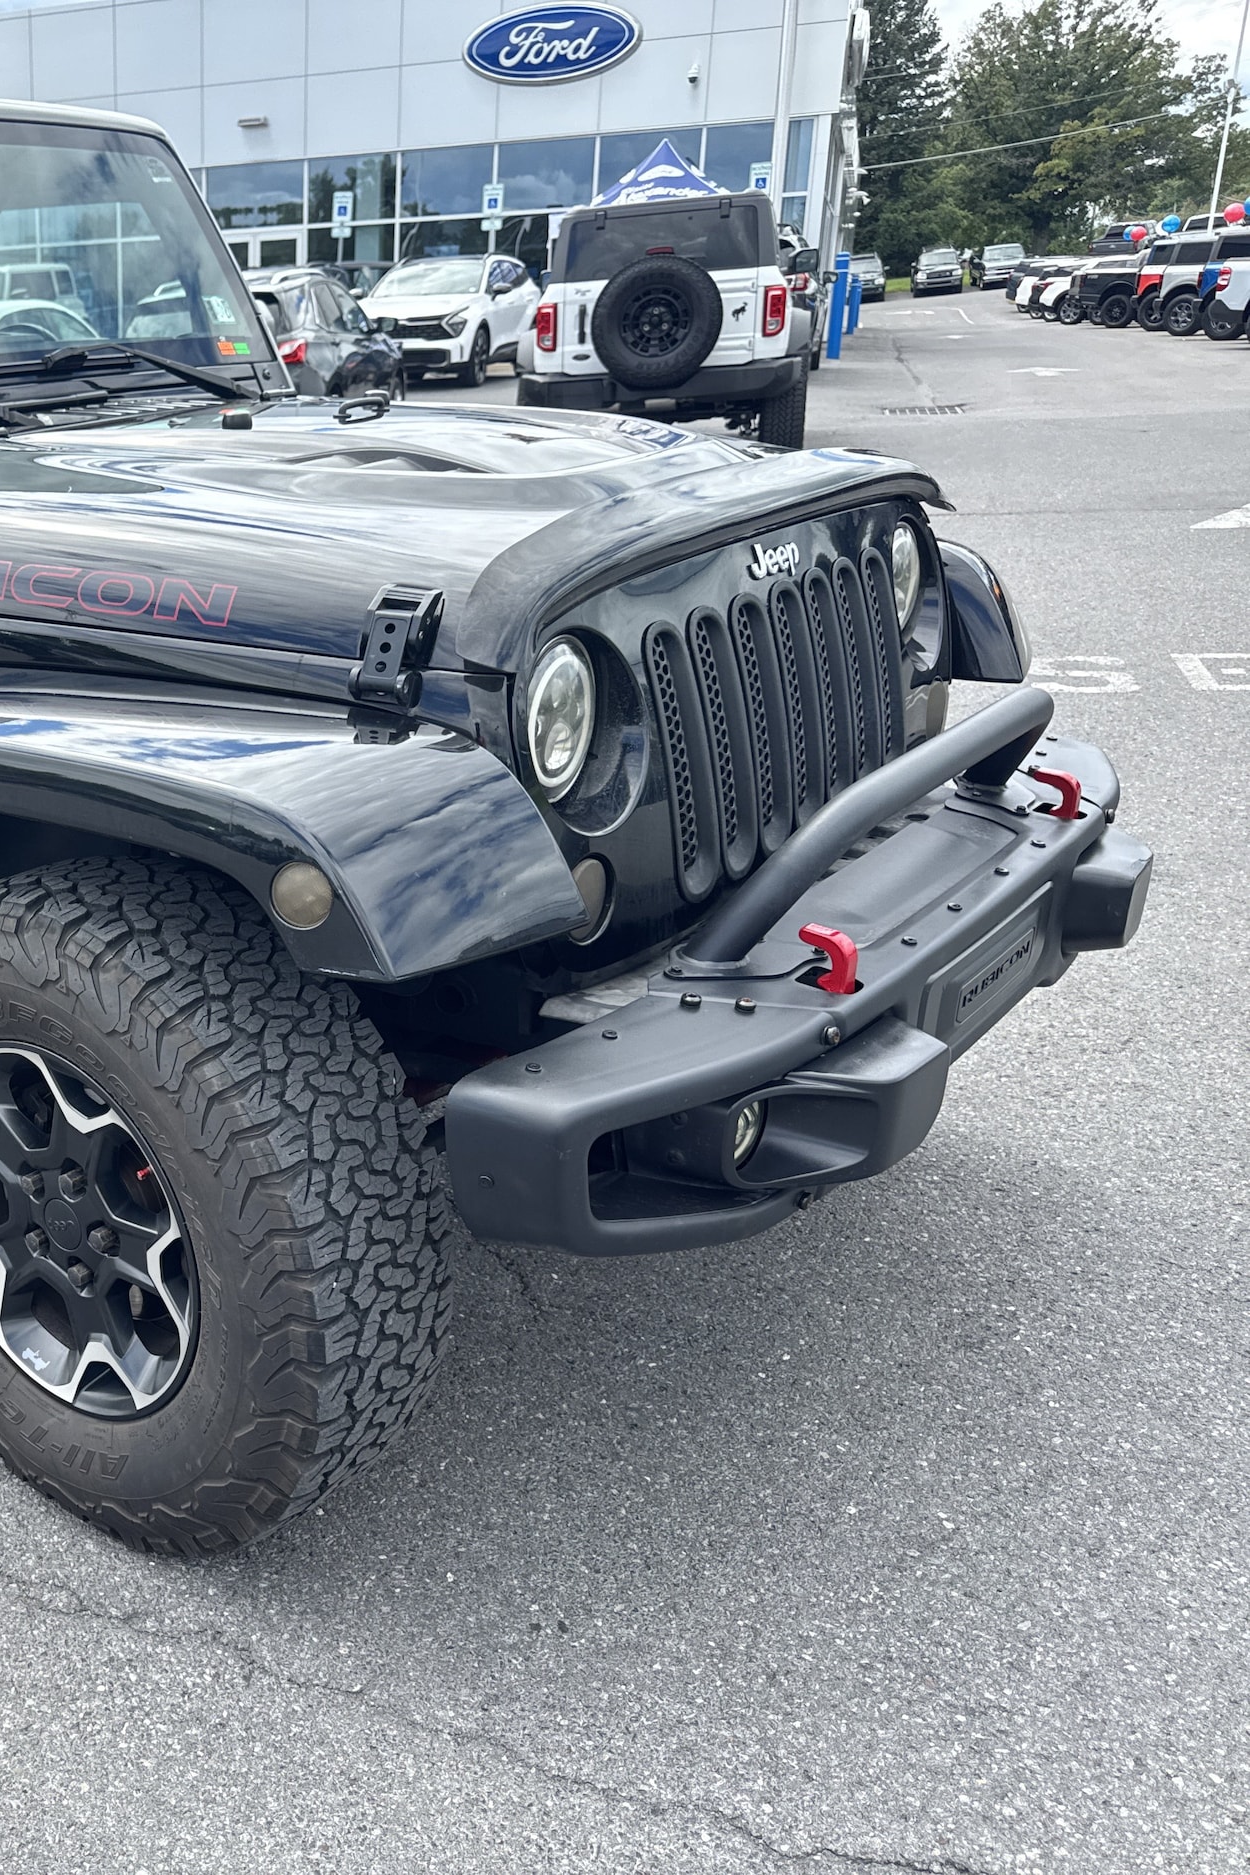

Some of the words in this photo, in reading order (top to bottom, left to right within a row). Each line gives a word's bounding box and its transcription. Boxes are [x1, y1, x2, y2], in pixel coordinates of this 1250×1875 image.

[498, 19, 600, 67] Ford
[748, 542, 800, 579] Jeep
[961, 940, 1031, 1008] RUBICON
